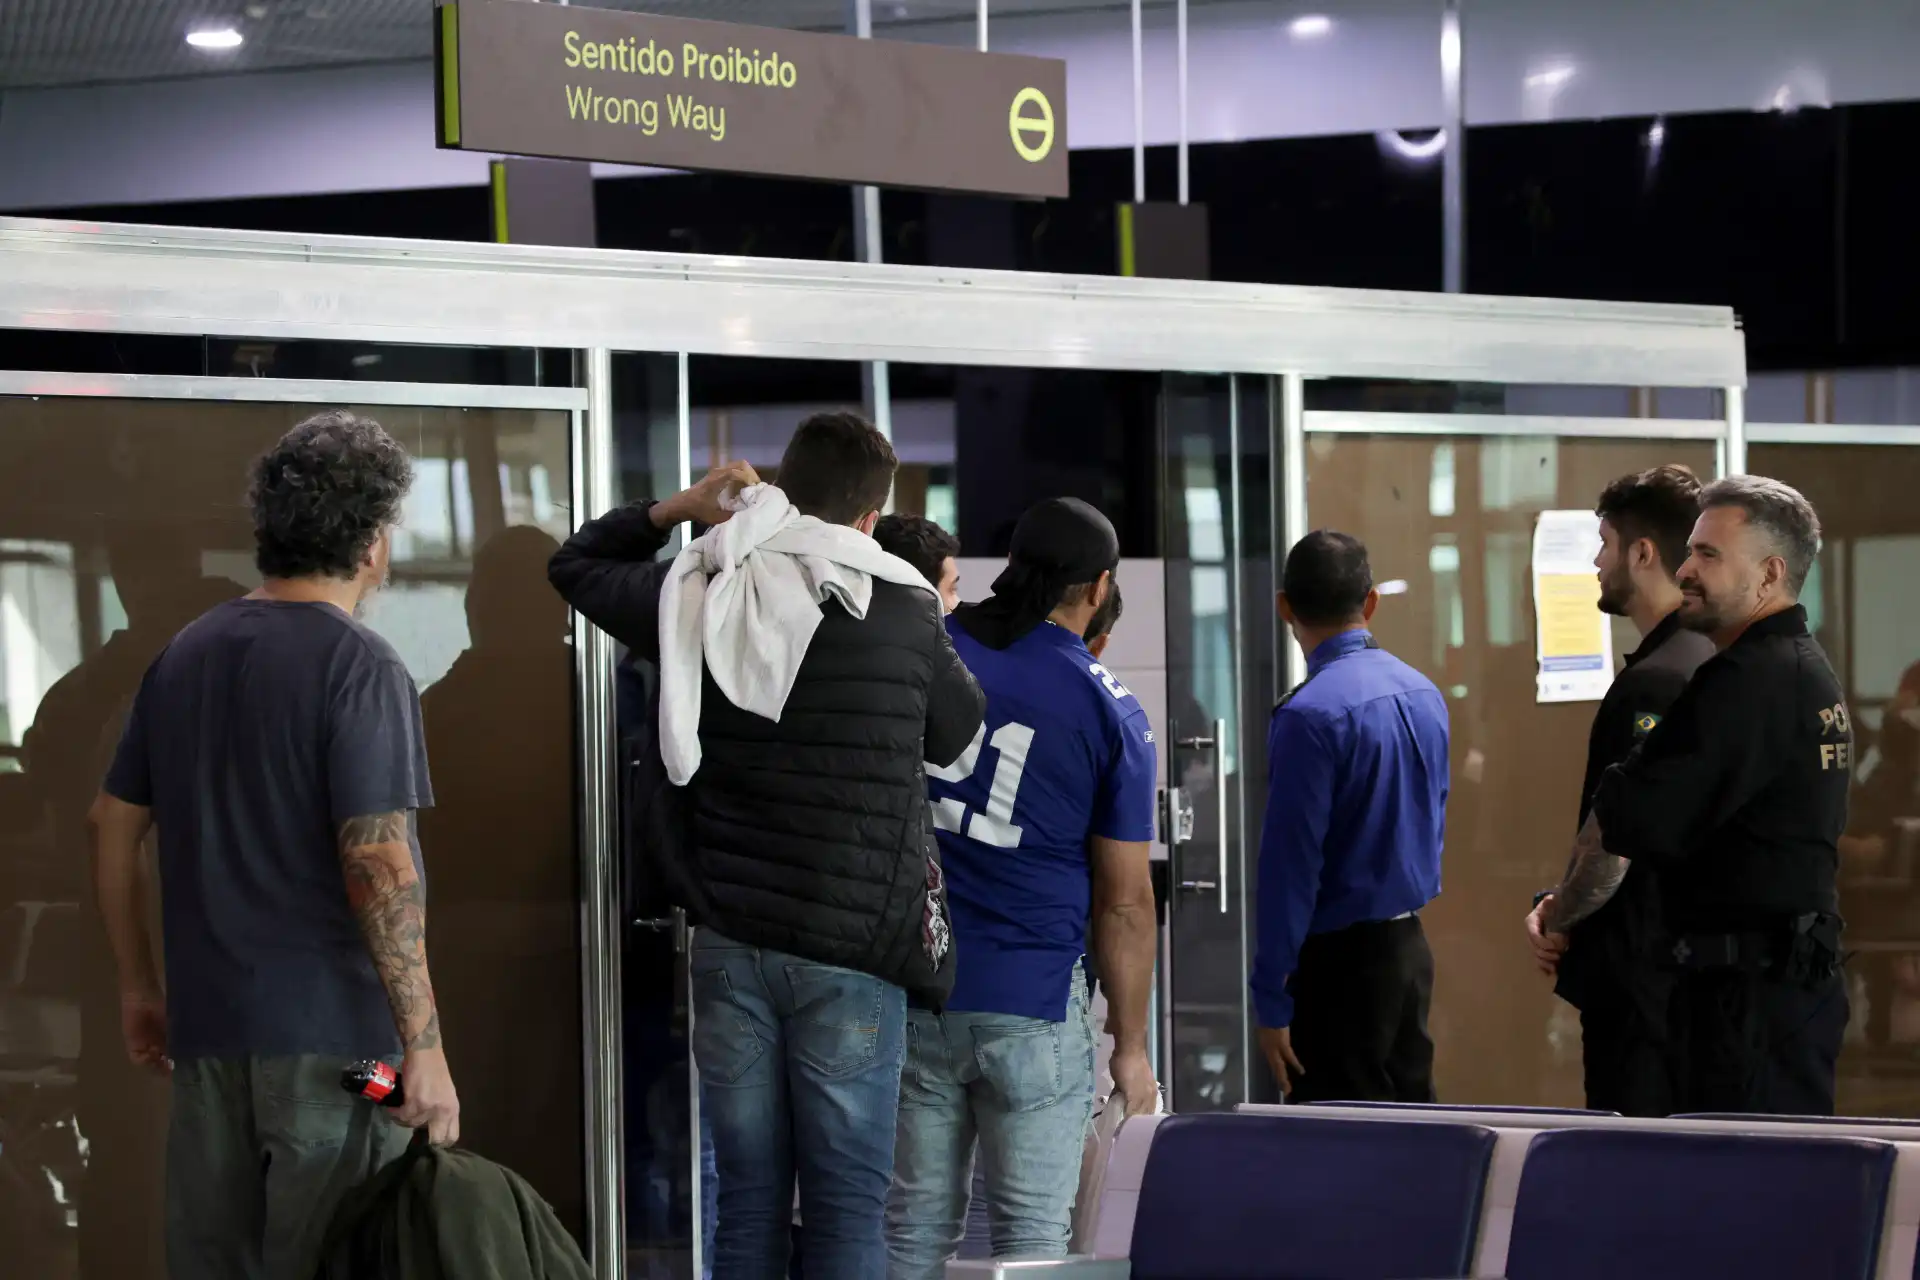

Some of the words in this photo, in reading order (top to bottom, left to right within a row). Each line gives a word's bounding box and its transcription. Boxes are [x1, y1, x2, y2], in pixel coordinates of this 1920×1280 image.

[564, 30, 674, 76] Sentido
[683, 44, 797, 88] Proibido
[565, 86, 659, 136] Wrong
[666, 94, 726, 141] Way
[1089, 663, 1133, 699] 2
[1818, 703, 1849, 736] PO
[1819, 743, 1850, 770] FE
